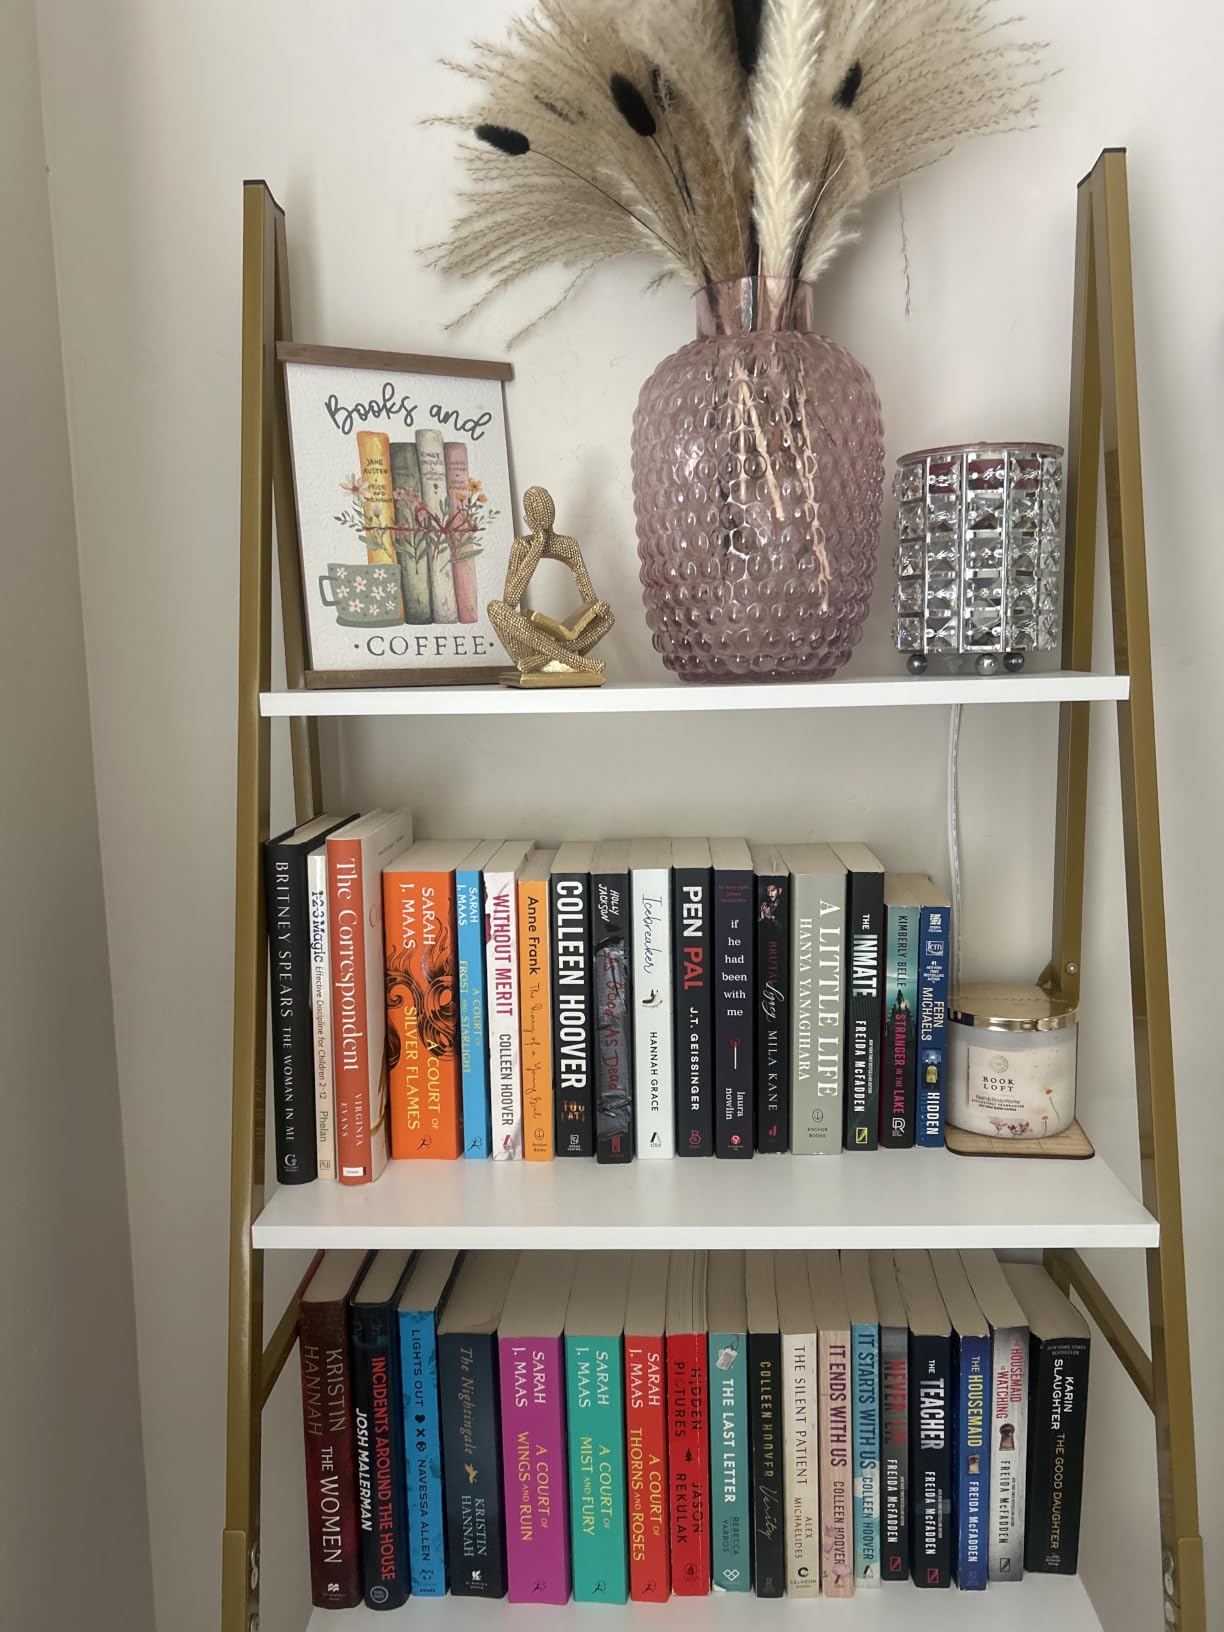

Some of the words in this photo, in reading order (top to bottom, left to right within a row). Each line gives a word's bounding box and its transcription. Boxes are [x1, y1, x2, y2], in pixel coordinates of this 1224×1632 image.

[325, 382, 418, 435] Books
[429, 403, 492, 441] and
[366, 636, 486, 656] COFFEE
[335, 859, 357, 900] The
[400, 884, 412, 894] J.
[276, 862, 291, 942] BRITNEY
[422, 887, 435, 945] SARAH
[527, 896, 540, 932] Anne
[598, 883, 610, 922] JACKSON
[610, 890, 621, 916] HOLLY
[682, 886, 703, 937] PEN
[819, 900, 840, 916] A
[311, 920, 327, 963] Magic
[402, 899, 416, 949] MAAS
[492, 894, 511, 963] WITHOUT
[557, 880, 584, 985] COLLEEN
[641, 893, 663, 974] Icebreaker
[730, 920, 740, 928] if
[862, 914, 871, 930] THE
[896, 915, 909, 958] KIMBERLY
[528, 937, 541, 975] Frank
[724, 955, 745, 964] had
[727, 938, 741, 946] he
[799, 918, 813, 973] HANYA
[278, 951, 293, 1018] SPEARS
[314, 966, 324, 998] Effective
[684, 947, 704, 990] PAL
[721, 973, 747, 981] been
[818, 926, 840, 1027] LITTLE
[852, 934, 878, 998] INMATE
[896, 962, 907, 988] BELLE
[335, 910, 363, 1071] Correspondent
[494, 968, 513, 1016] MERIT
[723, 989, 747, 999] with
[315, 1000, 326, 1034] Discipline
[689, 1007, 699, 1028] J.T.
[727, 1009, 744, 1017] me
[799, 978, 812, 1081] YANAGIHARA
[921, 987, 933, 1041] MICHAELS
[933, 1001, 945, 1028] FERN
[282, 1027, 293, 1049] THE
[317, 1036, 326, 1048] for
[404, 1006, 418, 1060] SILVER
[426, 1039, 438, 1051] A
[559, 995, 587, 1089] HOOVER
[768, 1030, 778, 1066] MILA
[855, 1021, 867, 1056] FREIDA
[894, 1014, 906, 1066] STRANGER
[317, 1050, 327, 1080] Children
[499, 1034, 512, 1080] COLLEEN
[649, 1031, 659, 1075] HANNAH
[690, 1034, 700, 1111] GEISSINGER
[817, 1037, 839, 1097] LIFE
[284, 1055, 294, 1101] WOMAN
[427, 1057, 440, 1112] COURT
[650, 1079, 659, 1112] GRACE
[768, 1073, 778, 1111] KANE
[854, 1061, 866, 1112] McFADDEN
[895, 1077, 903, 1088] THE
[983, 1076, 1015, 1086] BOOK
[983, 1083, 1014, 1092] LOFT
[285, 1109, 295, 1120] IN
[406, 1067, 421, 1129] FLAMES
[500, 1083, 513, 1125] HOOVER
[725, 1087, 735, 1120] nowlin
[736, 1091, 745, 1117] laura
[893, 1090, 905, 1113] LAKE
[926, 1092, 941, 1135] HIDDEN
[285, 1127, 295, 1142] ME
[319, 1111, 330, 1142] Phelan
[340, 1102, 349, 1138] EVANS
[352, 1093, 364, 1146] VIRGINIA
[431, 1118, 439, 1128] OF
[411, 1329, 423, 1376] LIGHTS
[512, 1347, 526, 1357] J.
[829, 1345, 846, 1361] IT
[859, 1333, 875, 1345] IT
[460, 1347, 474, 1371] The
[532, 1351, 547, 1403] SARAH
[793, 1345, 806, 1374] THE
[928, 1360, 936, 1374] THE
[971, 1356, 980, 1372] THE
[304, 1345, 323, 1436] HANNAH
[325, 1349, 346, 1432] KRISTIN
[371, 1356, 389, 1434] INCIDENTS
[414, 1380, 424, 1407] OUT
[514, 1362, 528, 1407] MAAS
[721, 1379, 734, 1407] THE
[759, 1361, 773, 1419] COLLEEN
[829, 1363, 847, 1401] ENDS
[859, 1352, 876, 1406] STARTS
[1050, 1359, 1064, 1430] SLAUGHTER
[1063, 1376, 1075, 1413] KARIN
[456, 1377, 475, 1455] Nightingale
[673, 1361, 687, 1437] PITURES
[689, 1369, 703, 1430] HIDDEN
[794, 1378, 807, 1424] SILENT
[920, 1378, 945, 1450] TEACHER
[967, 1375, 984, 1447] HOUSEMAID
[355, 1408, 369, 1446] JOSH
[722, 1412, 735, 1447] LAST
[829, 1405, 847, 1444] WITH
[859, 1408, 876, 1446] WITH
[1054, 1433, 1066, 1454] THE
[321, 1446, 334, 1472] THE
[375, 1436, 391, 1500] AROUND
[516, 1431, 531, 1482] WINGS
[535, 1444, 548, 1456] A
[762, 1424, 774, 1478] HOOVER
[796, 1430, 808, 1485] PATIENT
[830, 1447, 848, 1467] US
[860, 1450, 877, 1470] US
[358, 1449, 373, 1531] MALERMAN
[418, 1459, 429, 1517] NAVESSA
[536, 1462, 551, 1516] COURT
[723, 1453, 737, 1503] LETTER
[1053, 1457, 1064, 1489] GOOD
[521, 1484, 530, 1502] AND
[675, 1473, 688, 1543] REKULAK
[691, 1482, 704, 1534] JASON
[968, 1482, 980, 1514] FREIDA
[320, 1476, 342, 1563] WOMEN
[379, 1503, 393, 1530] THE
[520, 1505, 534, 1541] RUIN
[541, 1518, 549, 1529] OF
[758, 1485, 779, 1541] Verity
[794, 1497, 803, 1559] MICHAELIDES
[804, 1516, 813, 1538] ALEX
[1050, 1492, 1062, 1549] DAUGHTER
[421, 1521, 431, 1561] ALLEN
[721, 1520, 730, 1553] YARROS
[731, 1516, 740, 1555] REBECCA
[968, 1516, 979, 1562] McFADDEN
[380, 1532, 396, 1581] HOUSE
